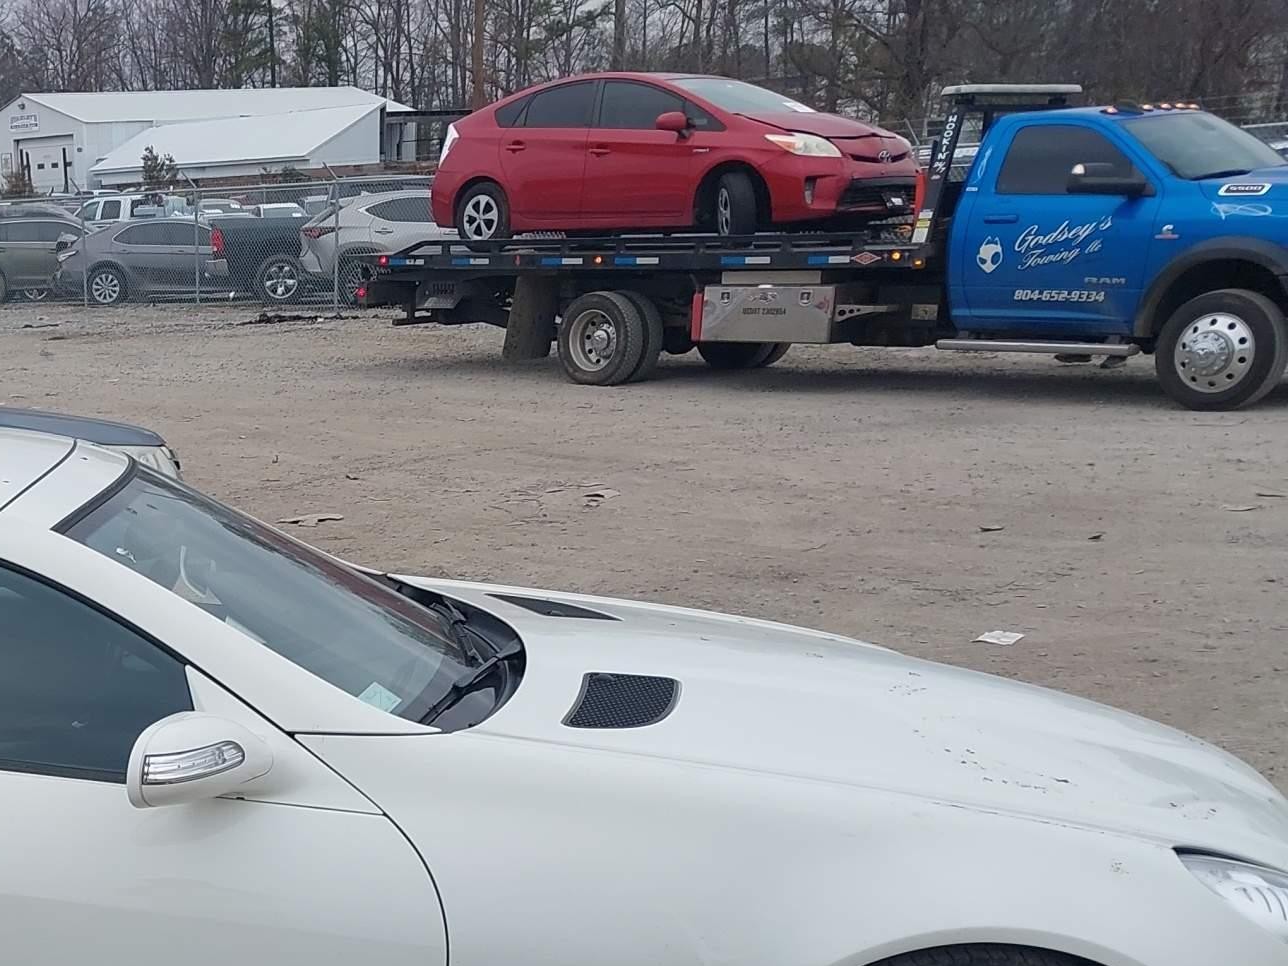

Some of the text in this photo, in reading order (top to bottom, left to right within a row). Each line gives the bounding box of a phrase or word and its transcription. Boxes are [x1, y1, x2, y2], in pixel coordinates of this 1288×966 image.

[1014, 215, 1112, 253] Godsey's
[1017, 247, 1081, 270] Towing
[1083, 276, 1127, 285] RAM
[1013, 289, 1105, 303] 804-652-9334
